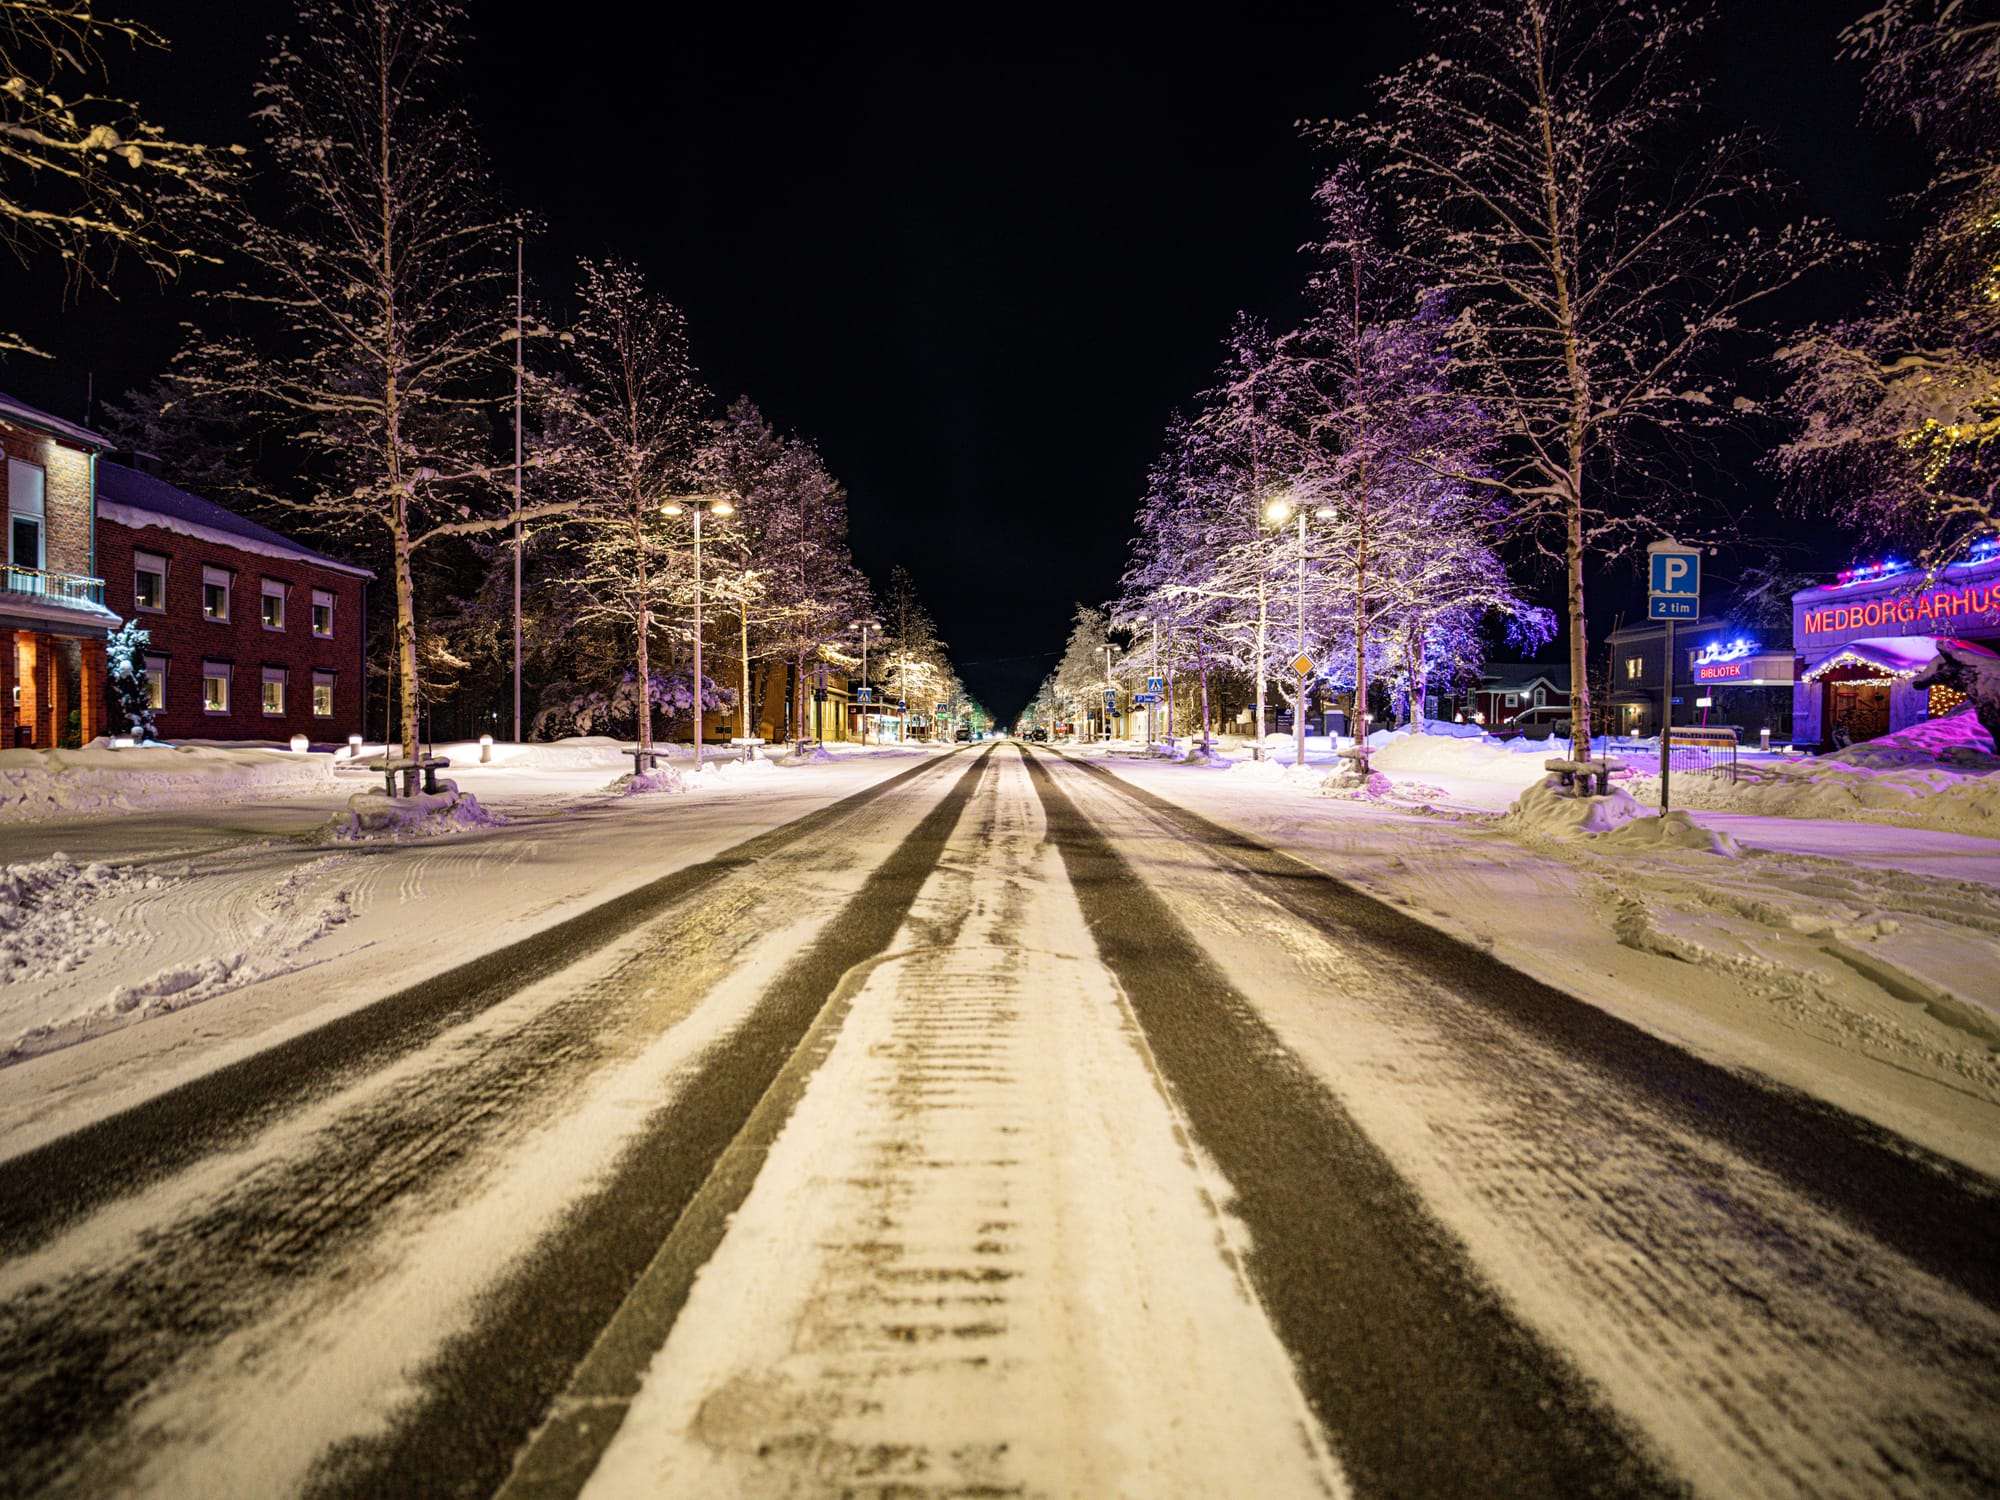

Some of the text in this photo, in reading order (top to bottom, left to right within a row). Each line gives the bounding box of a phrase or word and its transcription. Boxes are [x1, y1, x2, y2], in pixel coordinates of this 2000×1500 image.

[1665, 557, 1688, 590] P
[1658, 602, 1690, 613] 2 tim
[1804, 584, 2000, 635] MEDBORGARHUS
[1700, 664, 1741, 679] BIBLIOTEK
